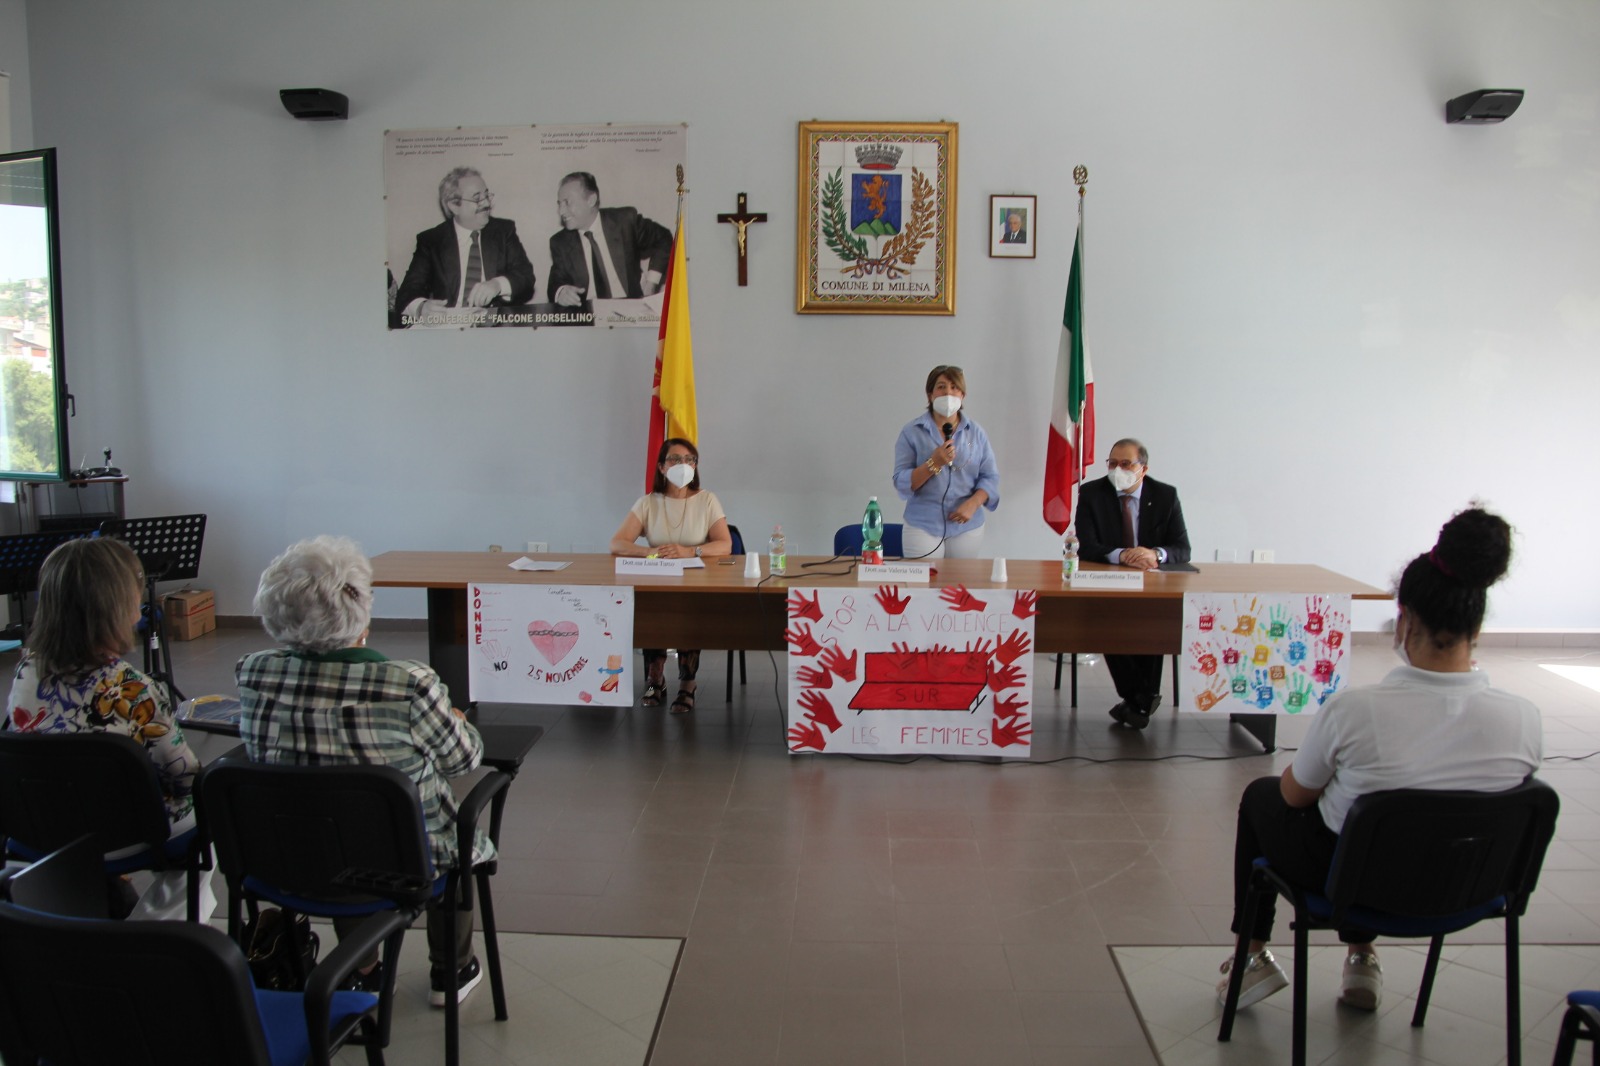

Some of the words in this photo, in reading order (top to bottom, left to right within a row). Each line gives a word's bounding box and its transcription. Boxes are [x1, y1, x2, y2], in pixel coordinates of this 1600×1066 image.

[821, 281, 868, 291] COMUNE
[872, 282, 884, 291] DI
[888, 282, 930, 292] MILENA
[401, 315, 424, 325] SALA
[427, 314, 486, 325] CONFERENZE
[888, 567, 908, 575] Valeria
[473, 586, 482, 645] DONNE
[820, 595, 856, 646] STOP
[887, 613, 912, 632] LA
[919, 613, 1011, 633] VIOLENCE
[494, 660, 508, 672] NO
[527, 664, 543, 681] 25
[545, 656, 589, 684] NOVEMBRE
[896, 687, 940, 702] SUR
[852, 726, 880, 745] LES
[900, 727, 990, 746] FEMMES
